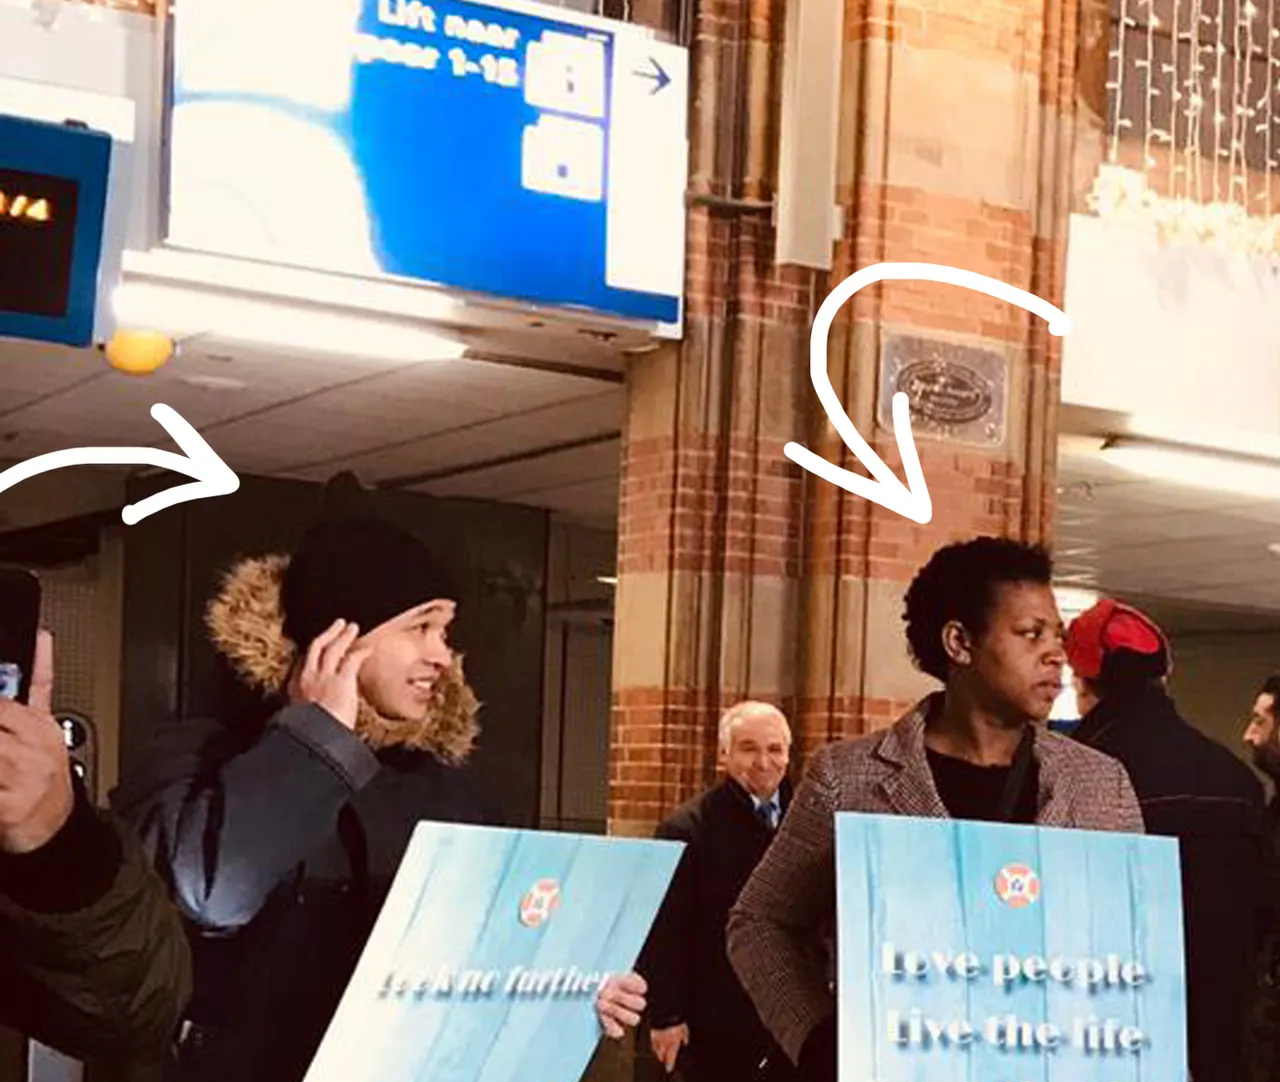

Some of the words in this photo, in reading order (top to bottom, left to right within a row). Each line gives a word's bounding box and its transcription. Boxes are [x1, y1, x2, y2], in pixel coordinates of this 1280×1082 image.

[881, 942, 985, 980] Love
[993, 949, 1150, 991] people
[886, 1007, 977, 1048] Live
[984, 1013, 1063, 1050] the
[1071, 1014, 1149, 1053] life
